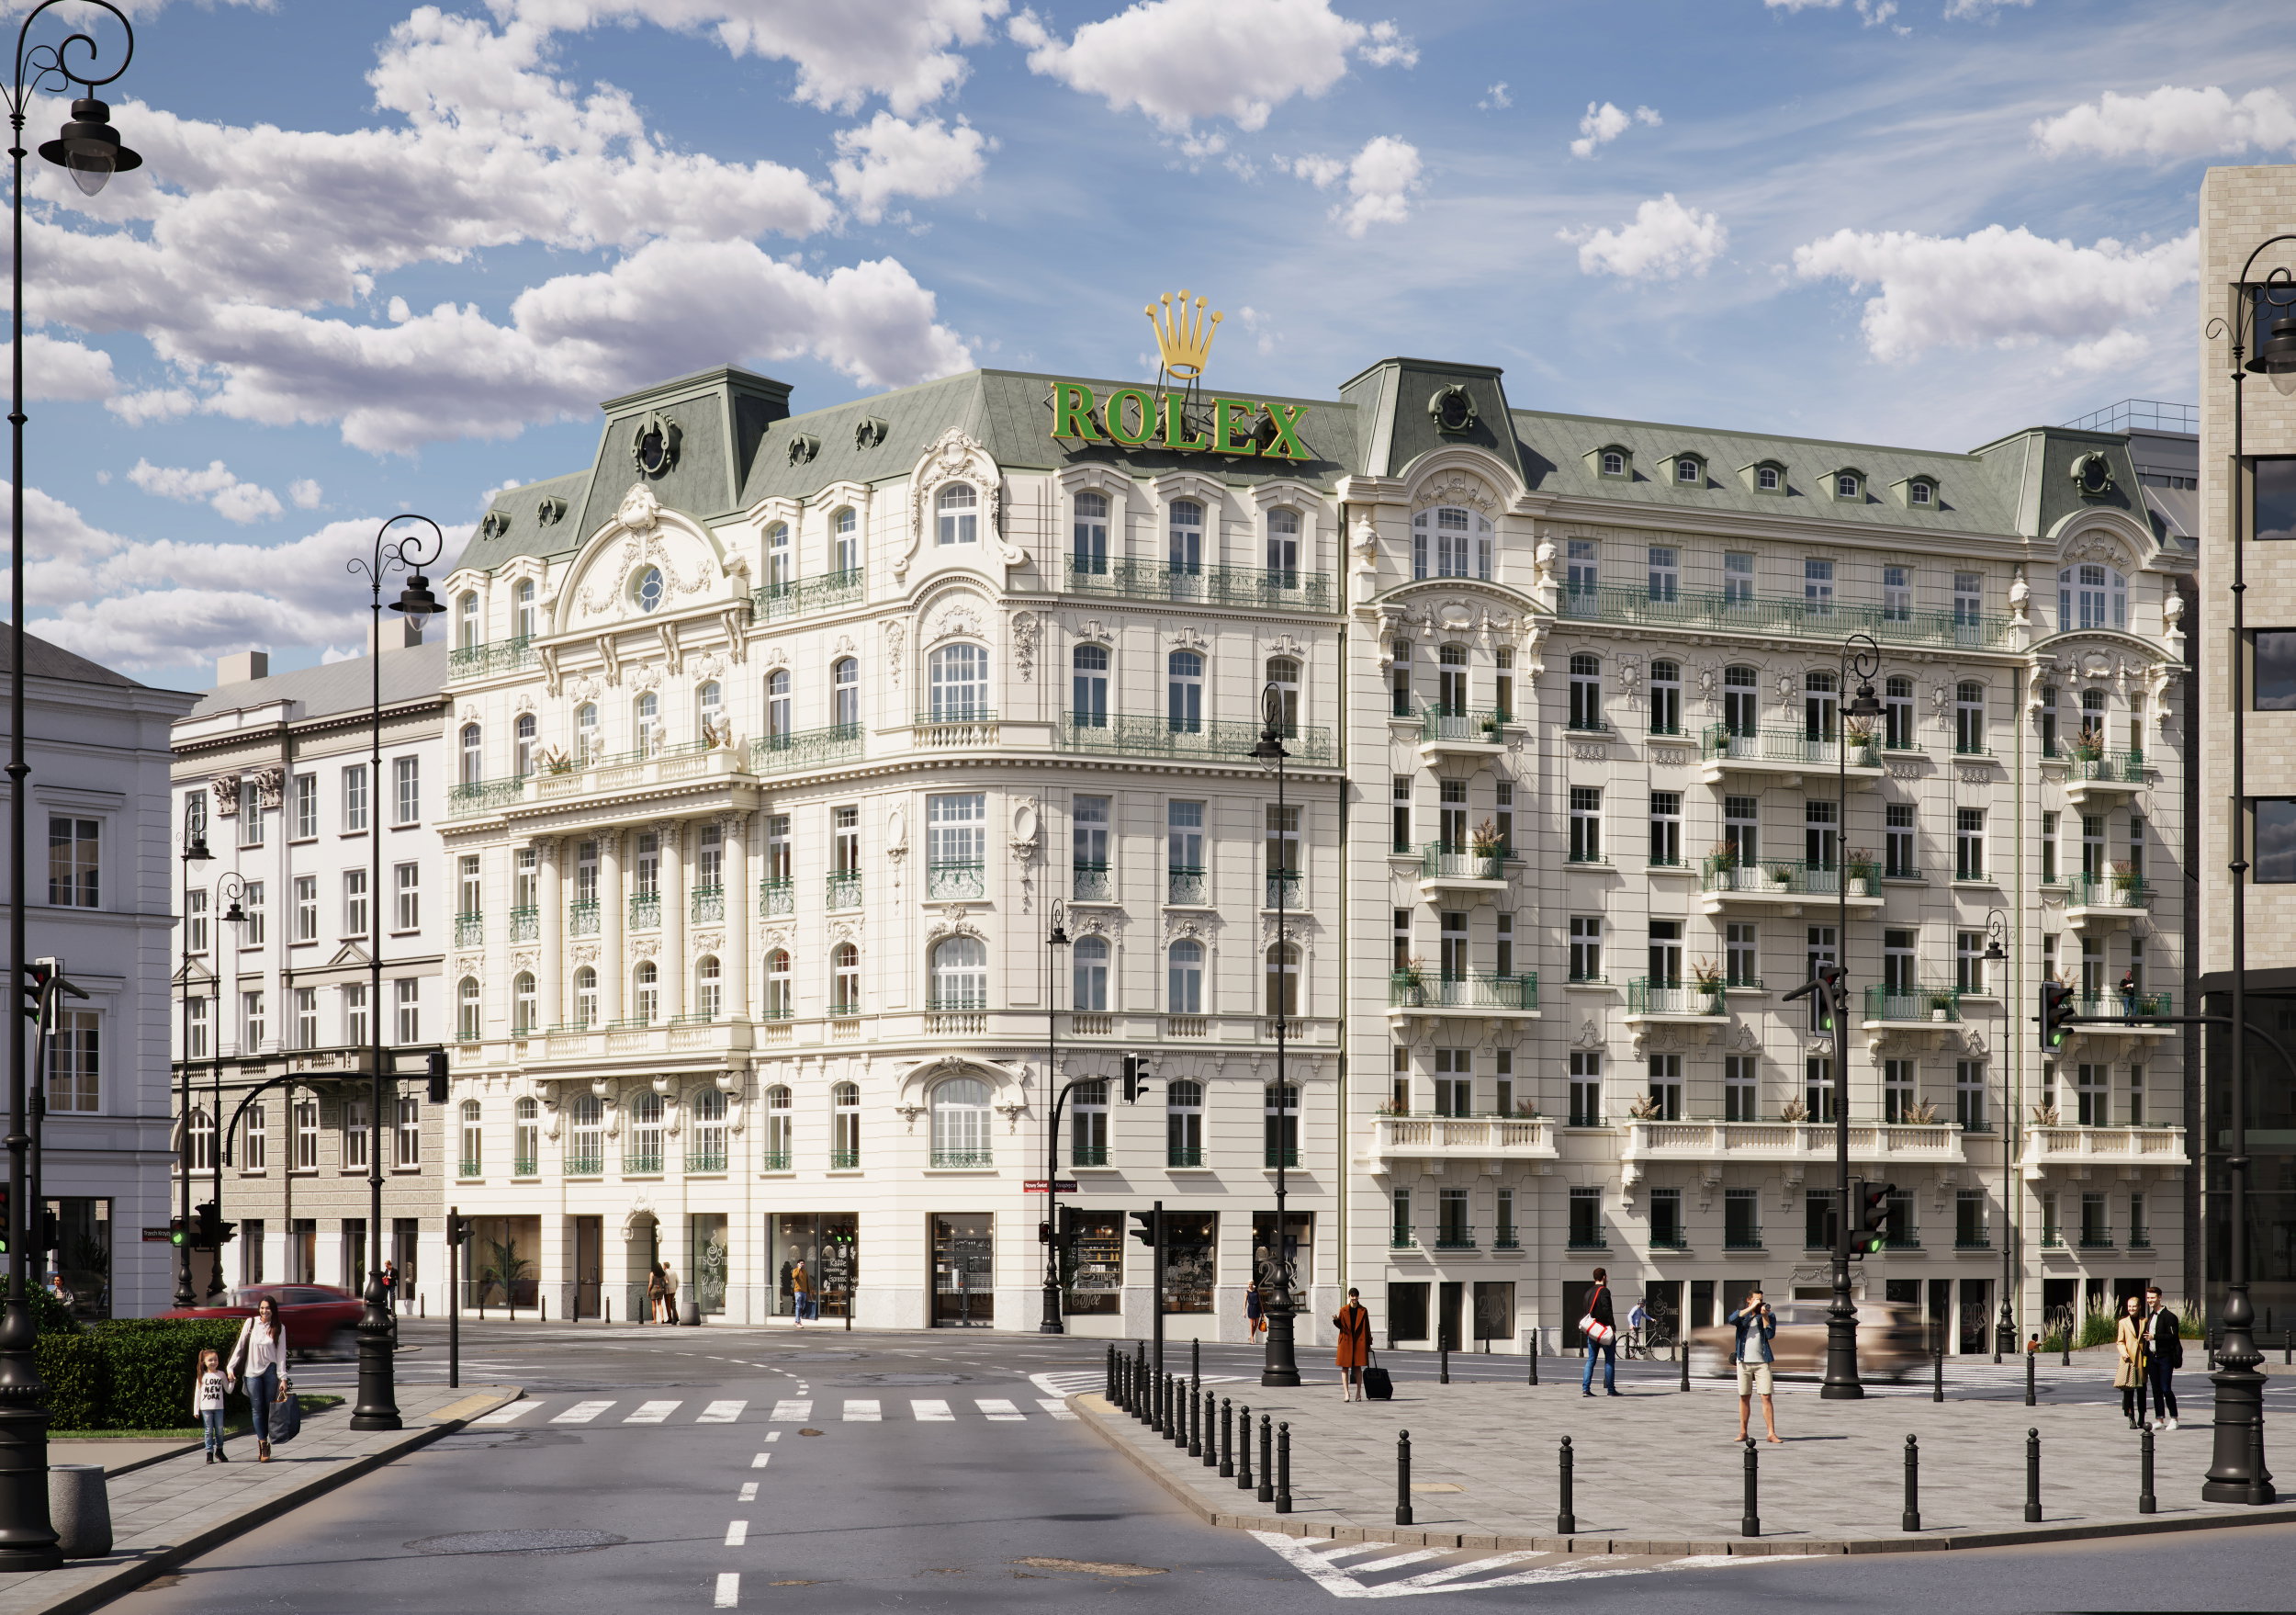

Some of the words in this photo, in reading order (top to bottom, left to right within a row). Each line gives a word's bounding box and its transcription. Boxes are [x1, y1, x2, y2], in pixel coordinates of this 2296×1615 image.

[1050, 381, 1311, 460] ROLEX
[701, 1274, 725, 1298] Coffee
[1072, 1293, 1101, 1308] Coffee
[201, 1392, 220, 1402] YORK
[204, 1385, 221, 1394] NEW
